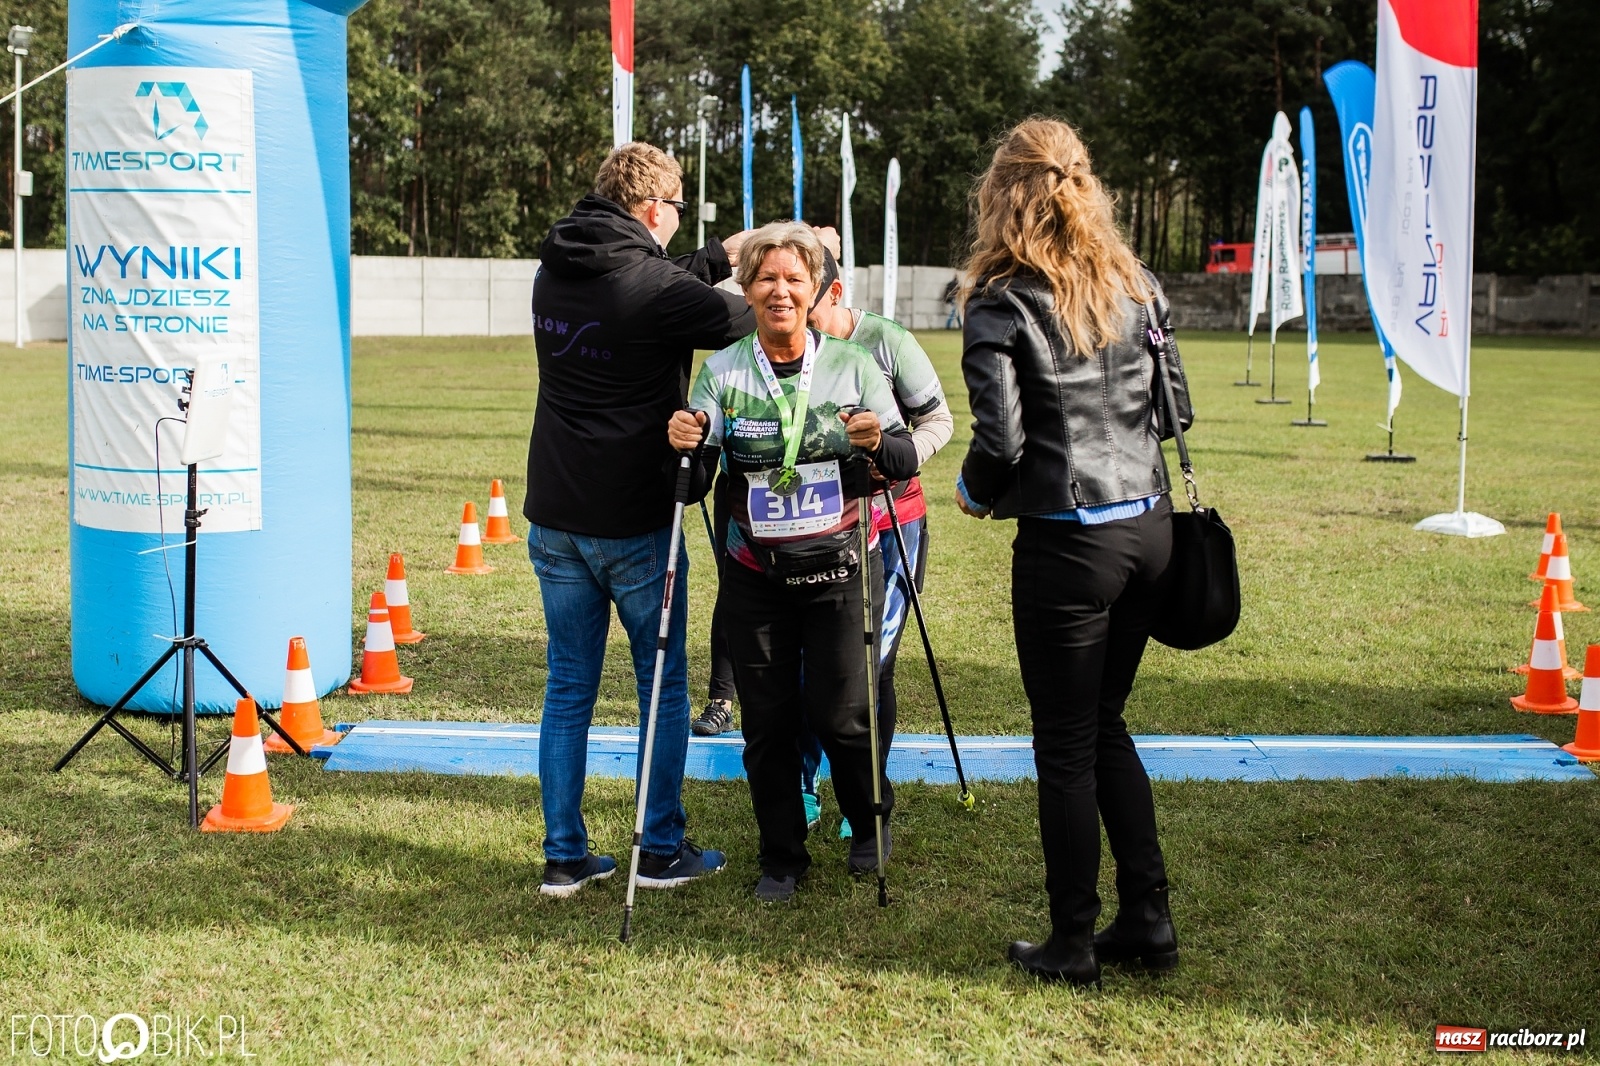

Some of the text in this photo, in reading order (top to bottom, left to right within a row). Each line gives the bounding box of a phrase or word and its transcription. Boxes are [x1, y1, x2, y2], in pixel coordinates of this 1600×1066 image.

[72, 151, 245, 172] TIMESPORT
[75, 244, 242, 280] WYNIKI
[81, 287, 231, 307] ZNAJDZIESZ
[1280, 277, 1293, 311] Rudy
[83, 313, 229, 334] NA STRONIE
[581, 346, 612, 360] PRO
[77, 364, 193, 384] TIME-SPOR
[765, 487, 824, 519] 314
[786, 566, 849, 586] SPORTS
